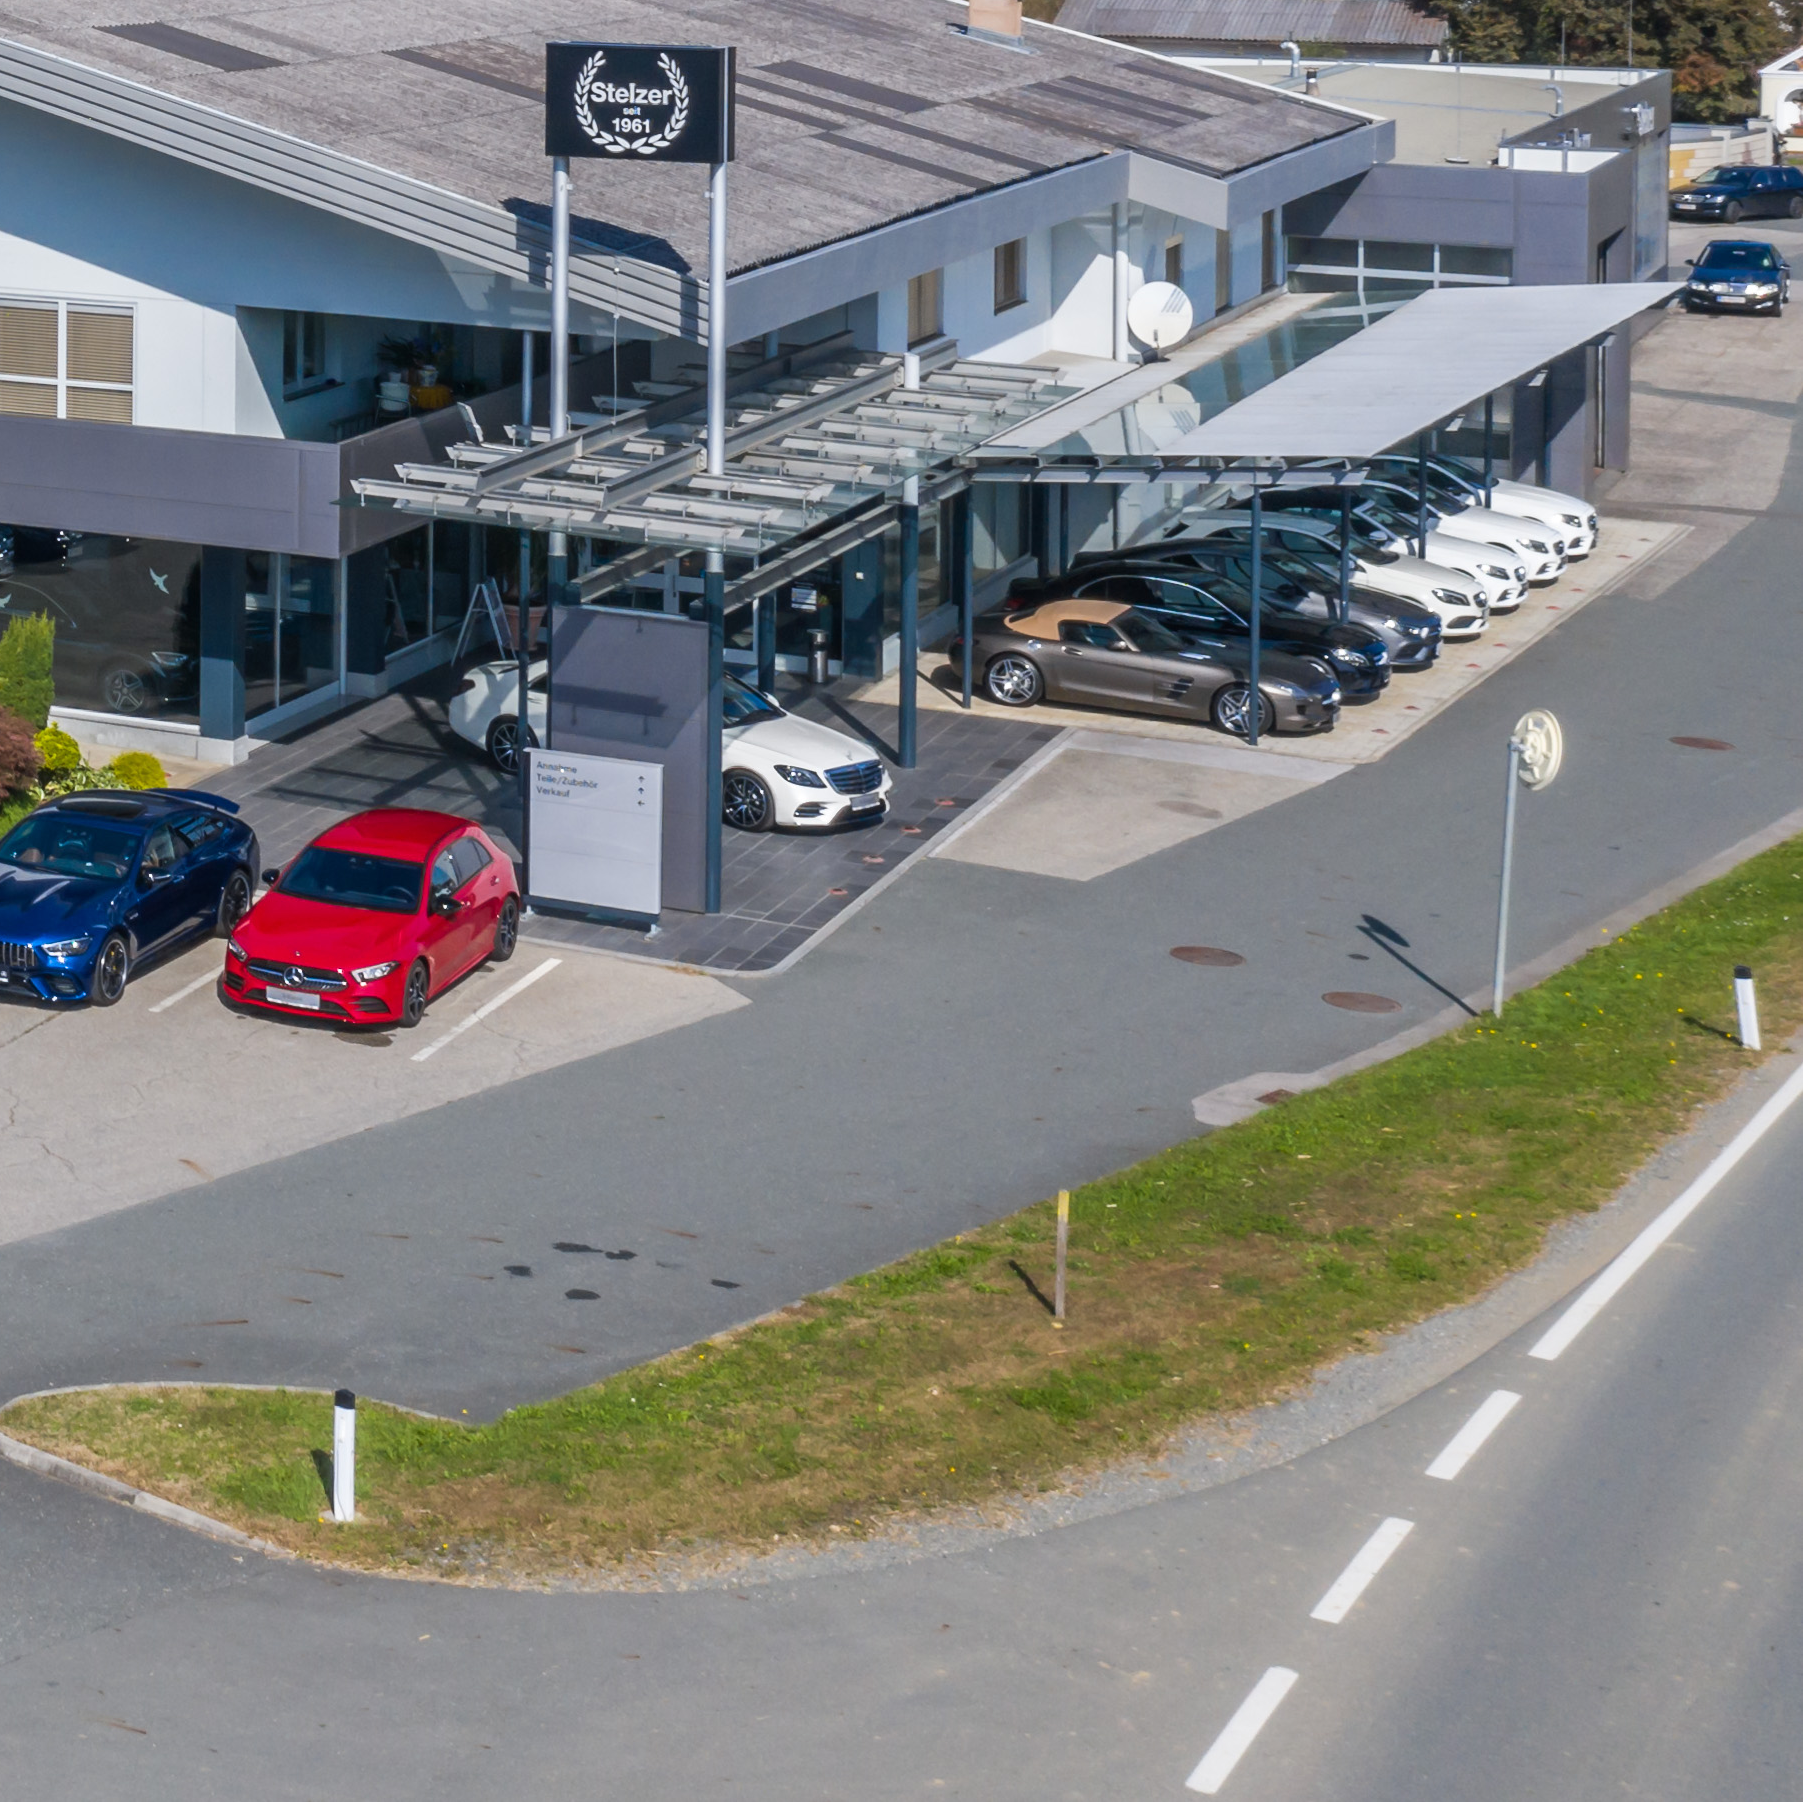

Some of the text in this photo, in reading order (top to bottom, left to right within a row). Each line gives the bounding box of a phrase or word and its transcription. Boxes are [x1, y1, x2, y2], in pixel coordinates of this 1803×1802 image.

[590, 81, 673, 105] Stelzer
[622, 106, 641, 116] seit
[611, 118, 651, 134] 1961
[537, 760, 577, 774] Annahme
[536, 773, 599, 789] Teile/Zubehör
[536, 786, 571, 798] Verkauf
